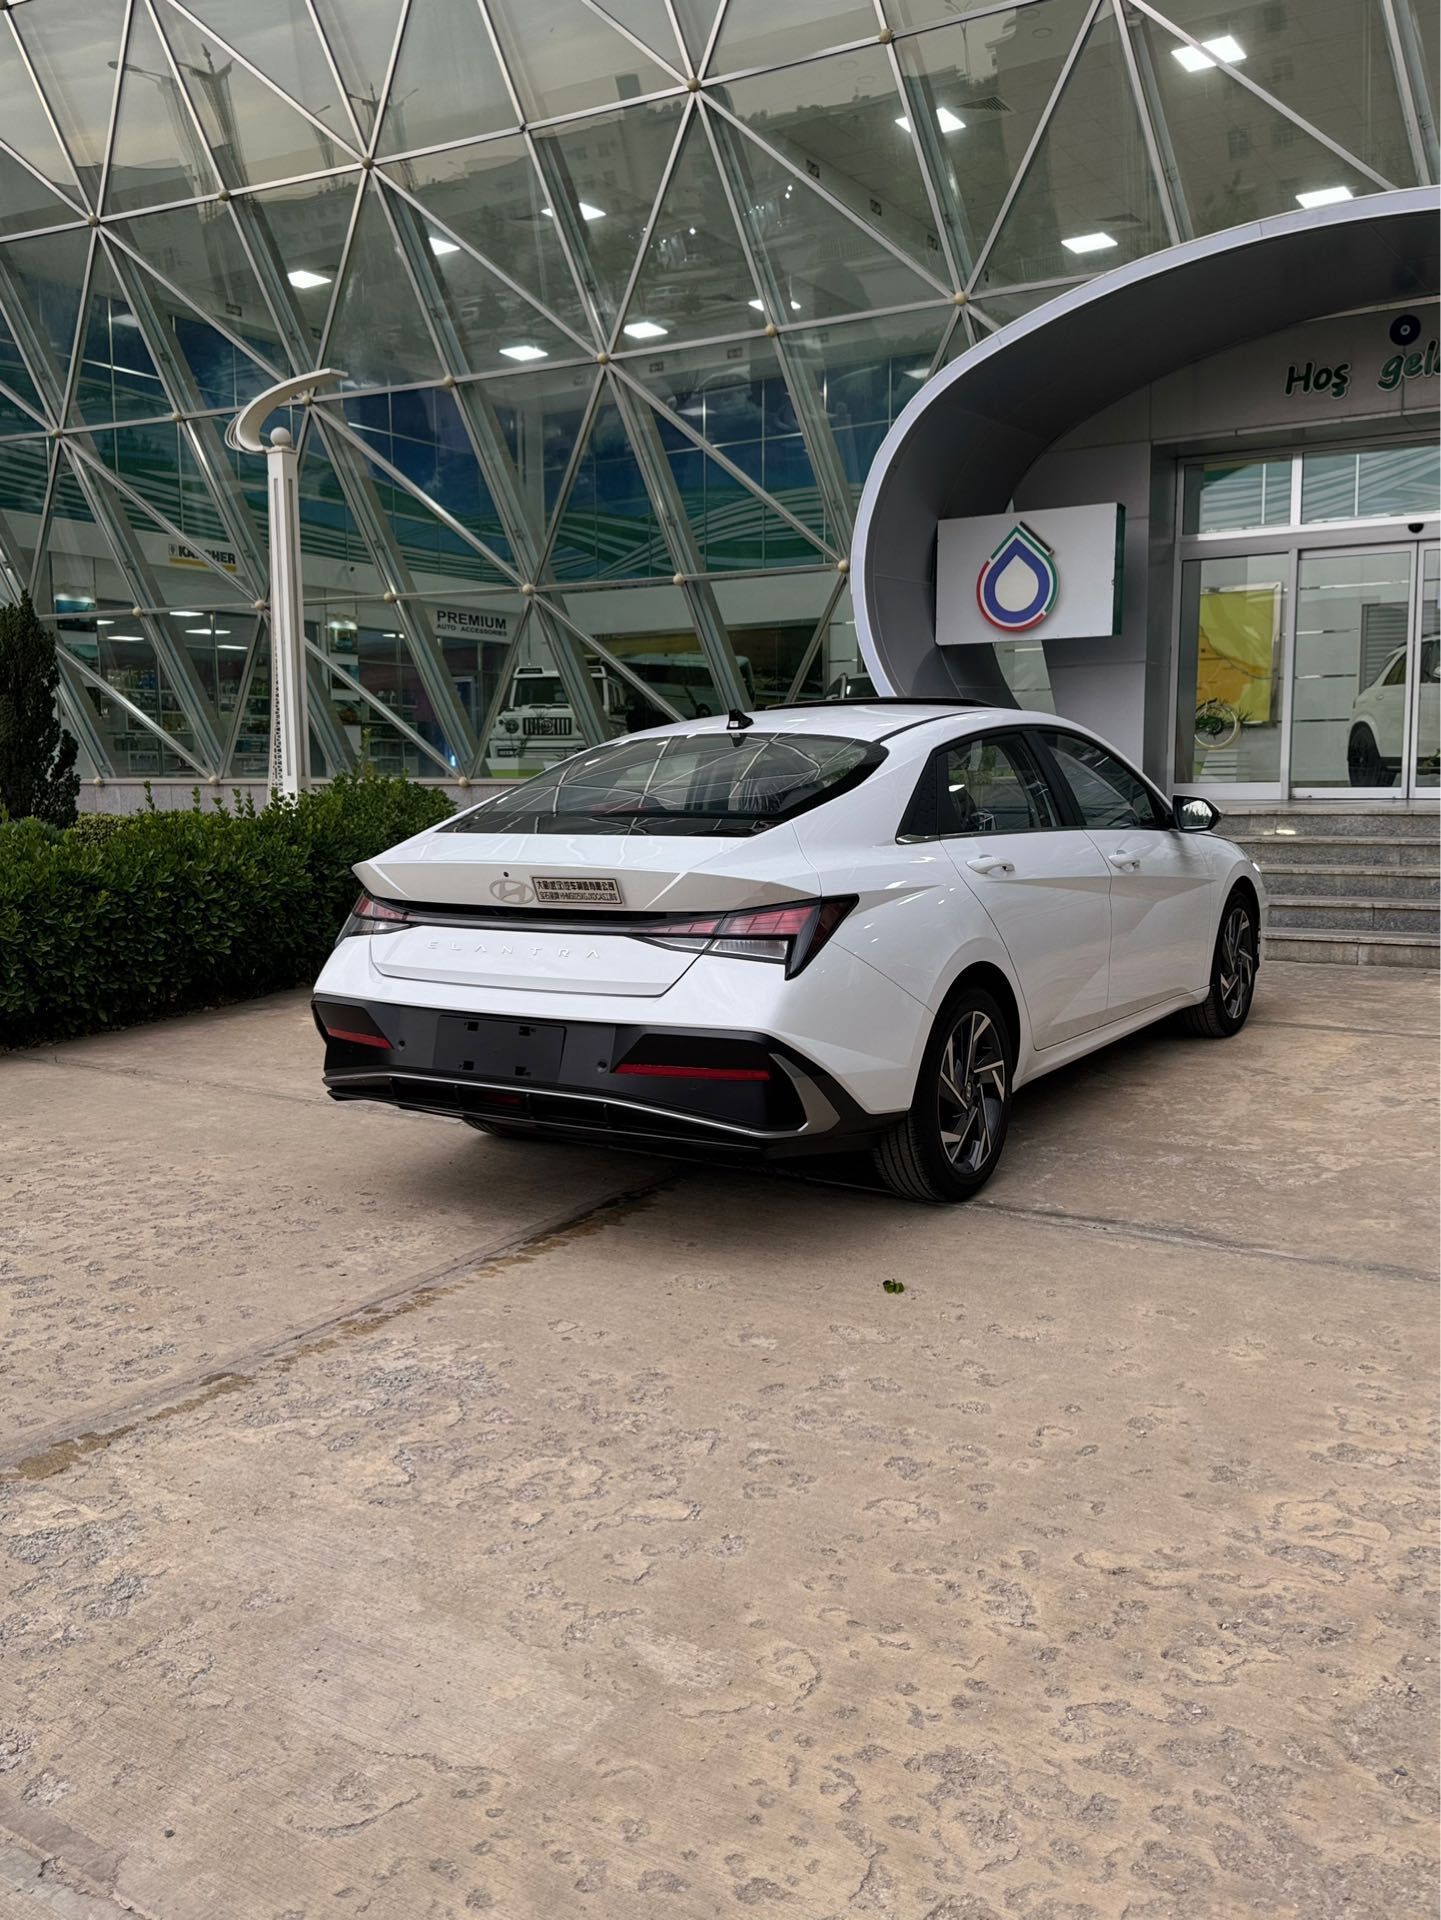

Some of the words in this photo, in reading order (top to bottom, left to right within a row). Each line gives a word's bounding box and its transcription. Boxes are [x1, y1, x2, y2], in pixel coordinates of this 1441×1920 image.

[1285, 361, 1350, 398] Hoş
[437, 610, 506, 630] PREMIUM
[437, 623, 457, 631] AUTO
[461, 626, 507, 636] ACCESSORIES
[427, 940, 601, 959] ELANTRA
